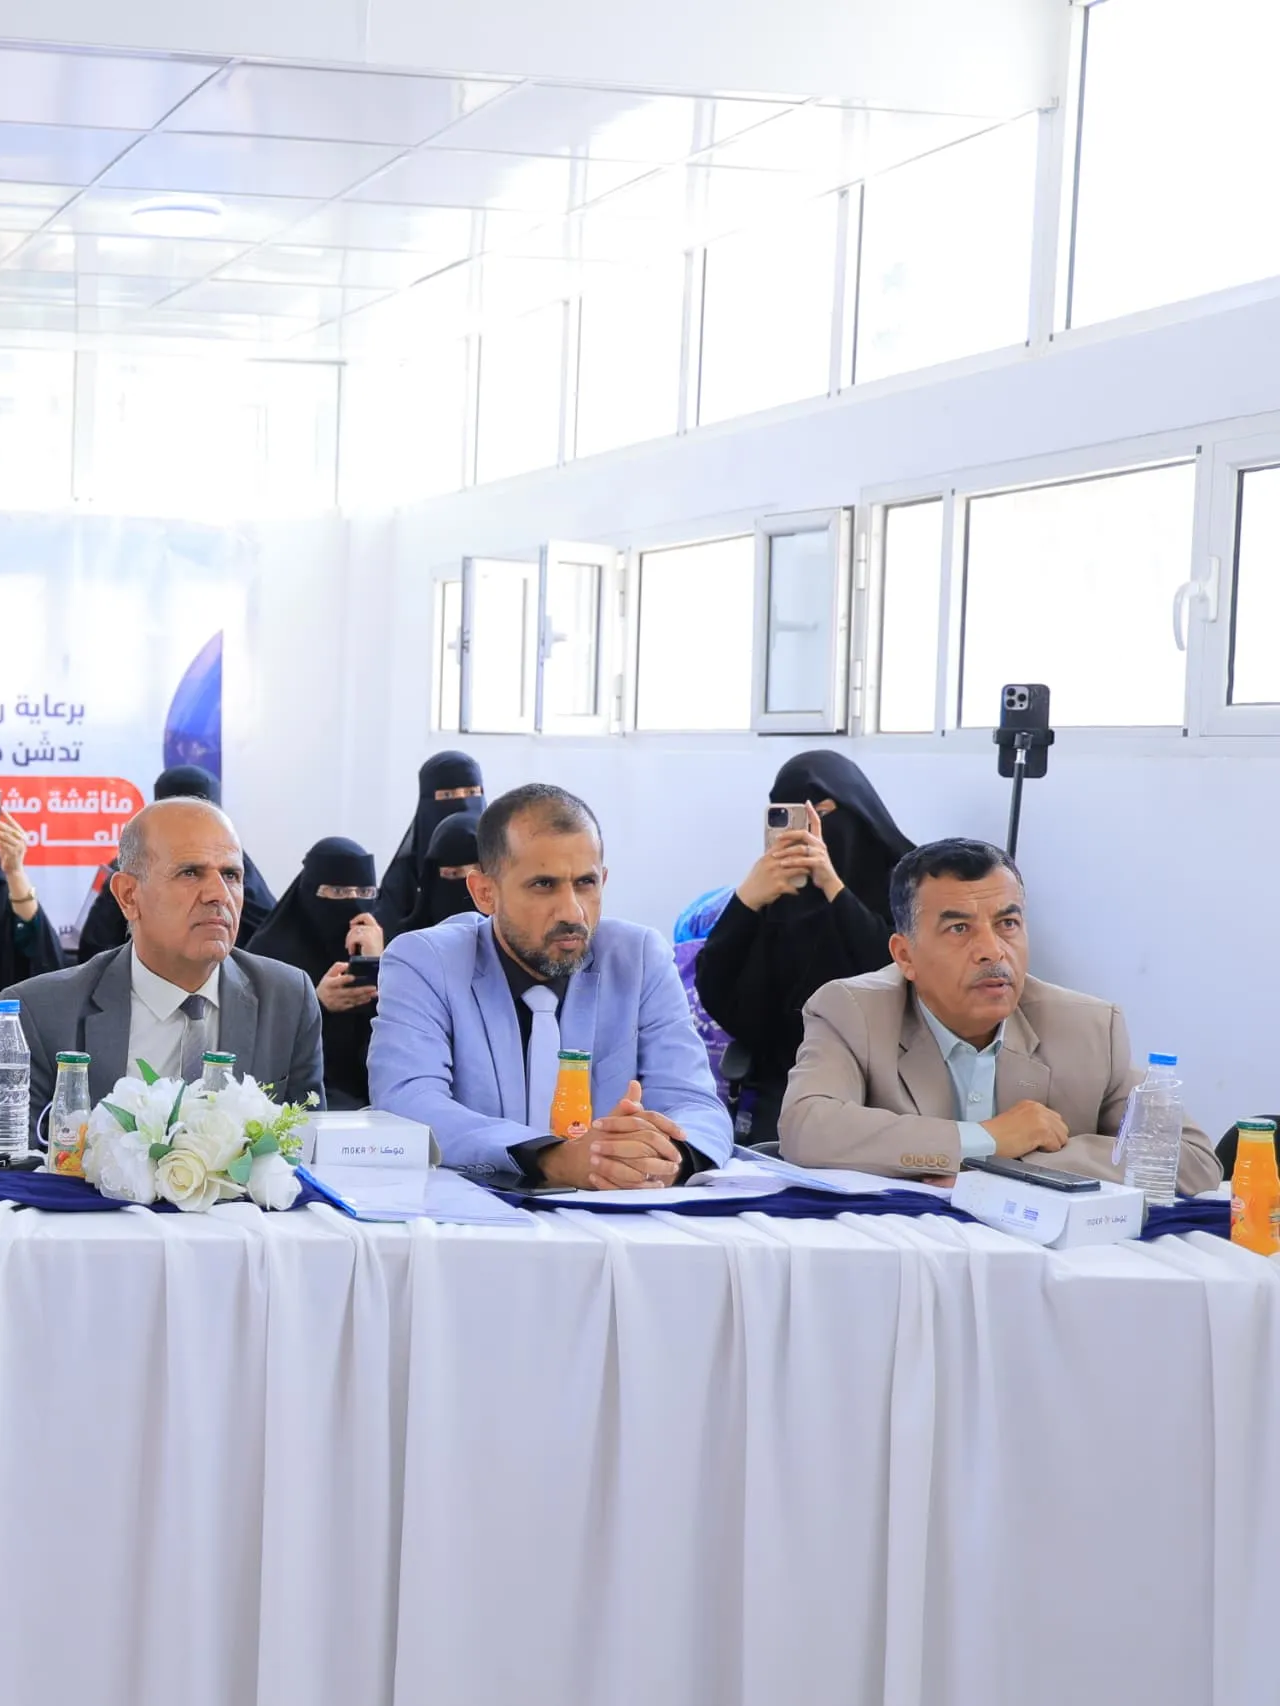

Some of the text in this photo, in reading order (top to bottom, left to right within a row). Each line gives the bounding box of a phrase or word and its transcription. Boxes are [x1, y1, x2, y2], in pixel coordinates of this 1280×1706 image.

[15, 694, 85, 724] برعاية
[46, 787, 134, 814] مناقشة
[26, 823, 125, 847] لعام
[380, 1146, 404, 1155] موكا
